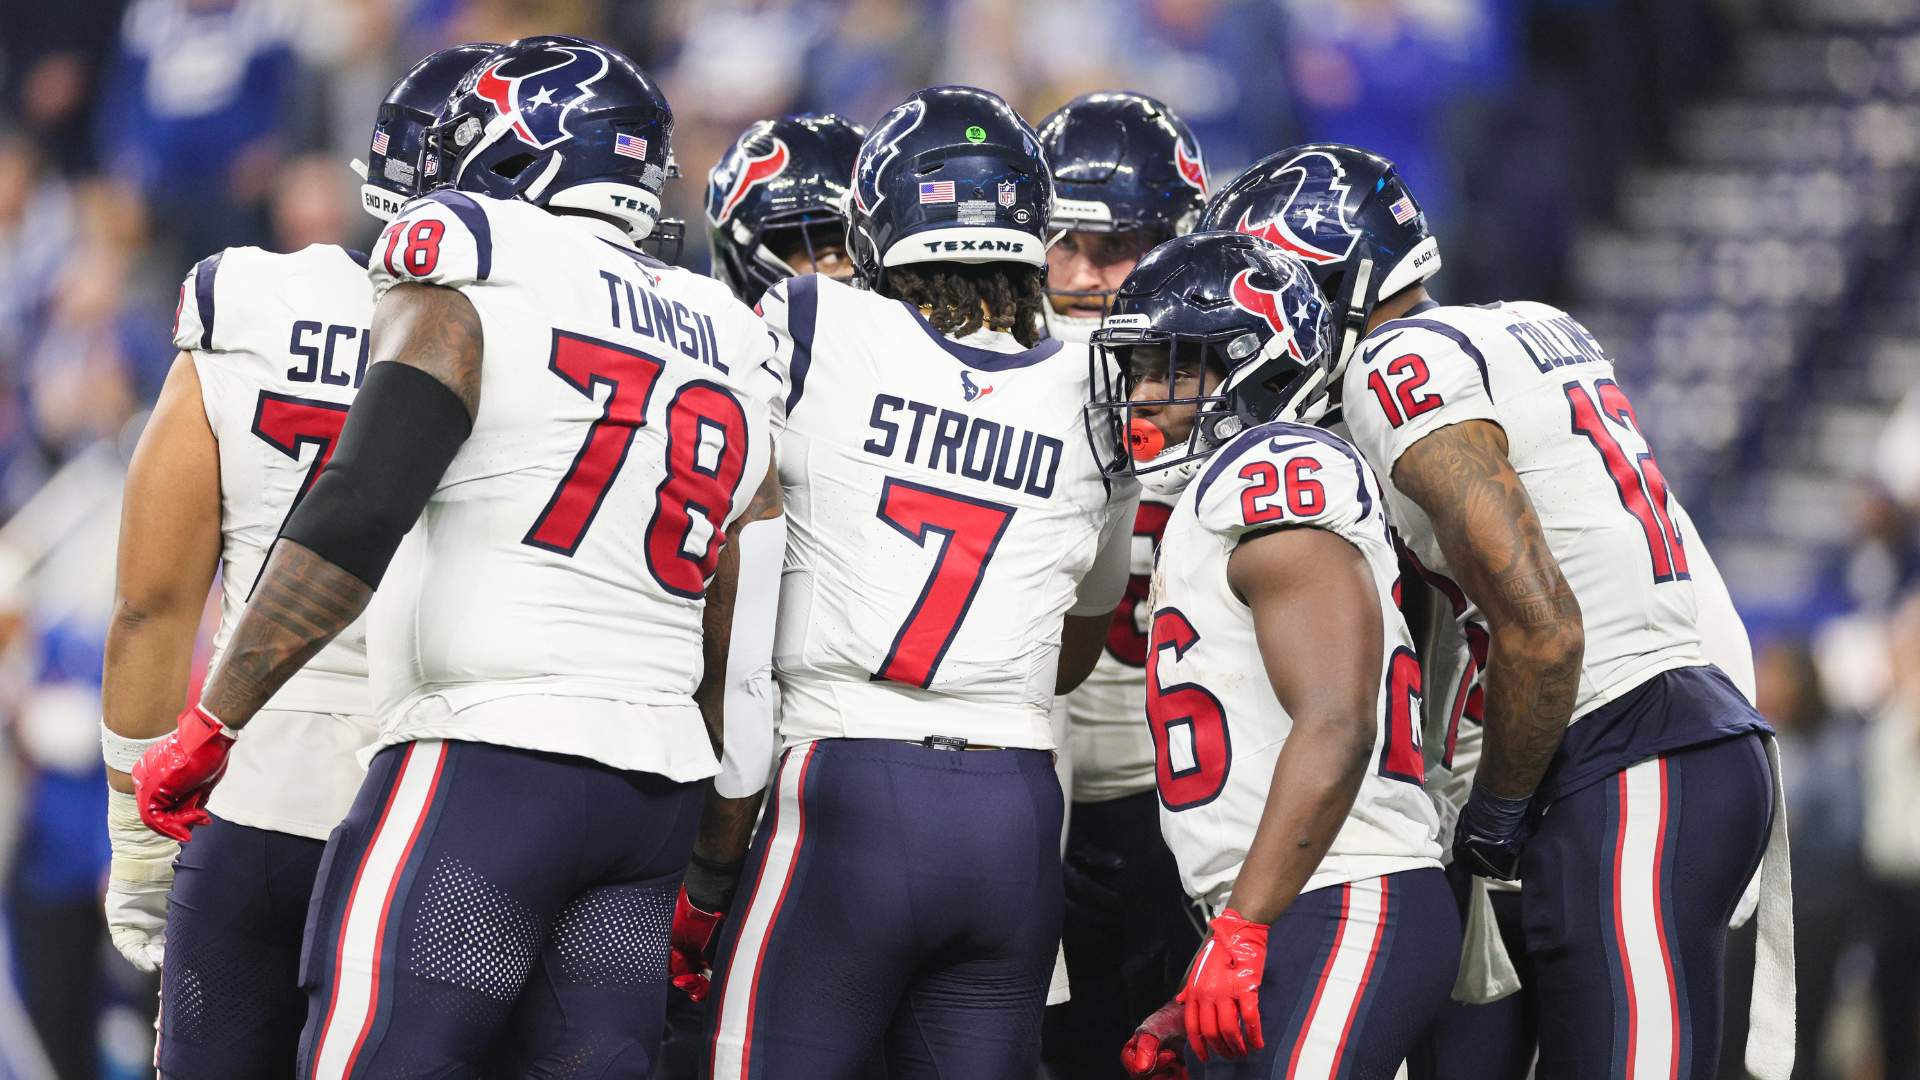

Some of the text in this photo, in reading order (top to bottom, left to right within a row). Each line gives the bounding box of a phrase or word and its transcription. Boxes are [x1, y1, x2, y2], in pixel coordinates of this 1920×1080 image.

[365, 192, 380, 209] END
[1001, 192, 1013, 204] NFL
[381, 218, 446, 279] 78
[923, 240, 1024, 253] TEXANS
[1413, 249, 1433, 268] BLACK
[600, 269, 730, 377] TUNSIL
[1368, 352, 1444, 430] 12
[521, 327, 749, 601] 78
[863, 393, 1065, 499] STROUD
[1562, 378, 1692, 584] 12
[1237, 456, 1326, 526] 26
[869, 476, 1018, 690] 7
[1145, 606, 1232, 812] 6
